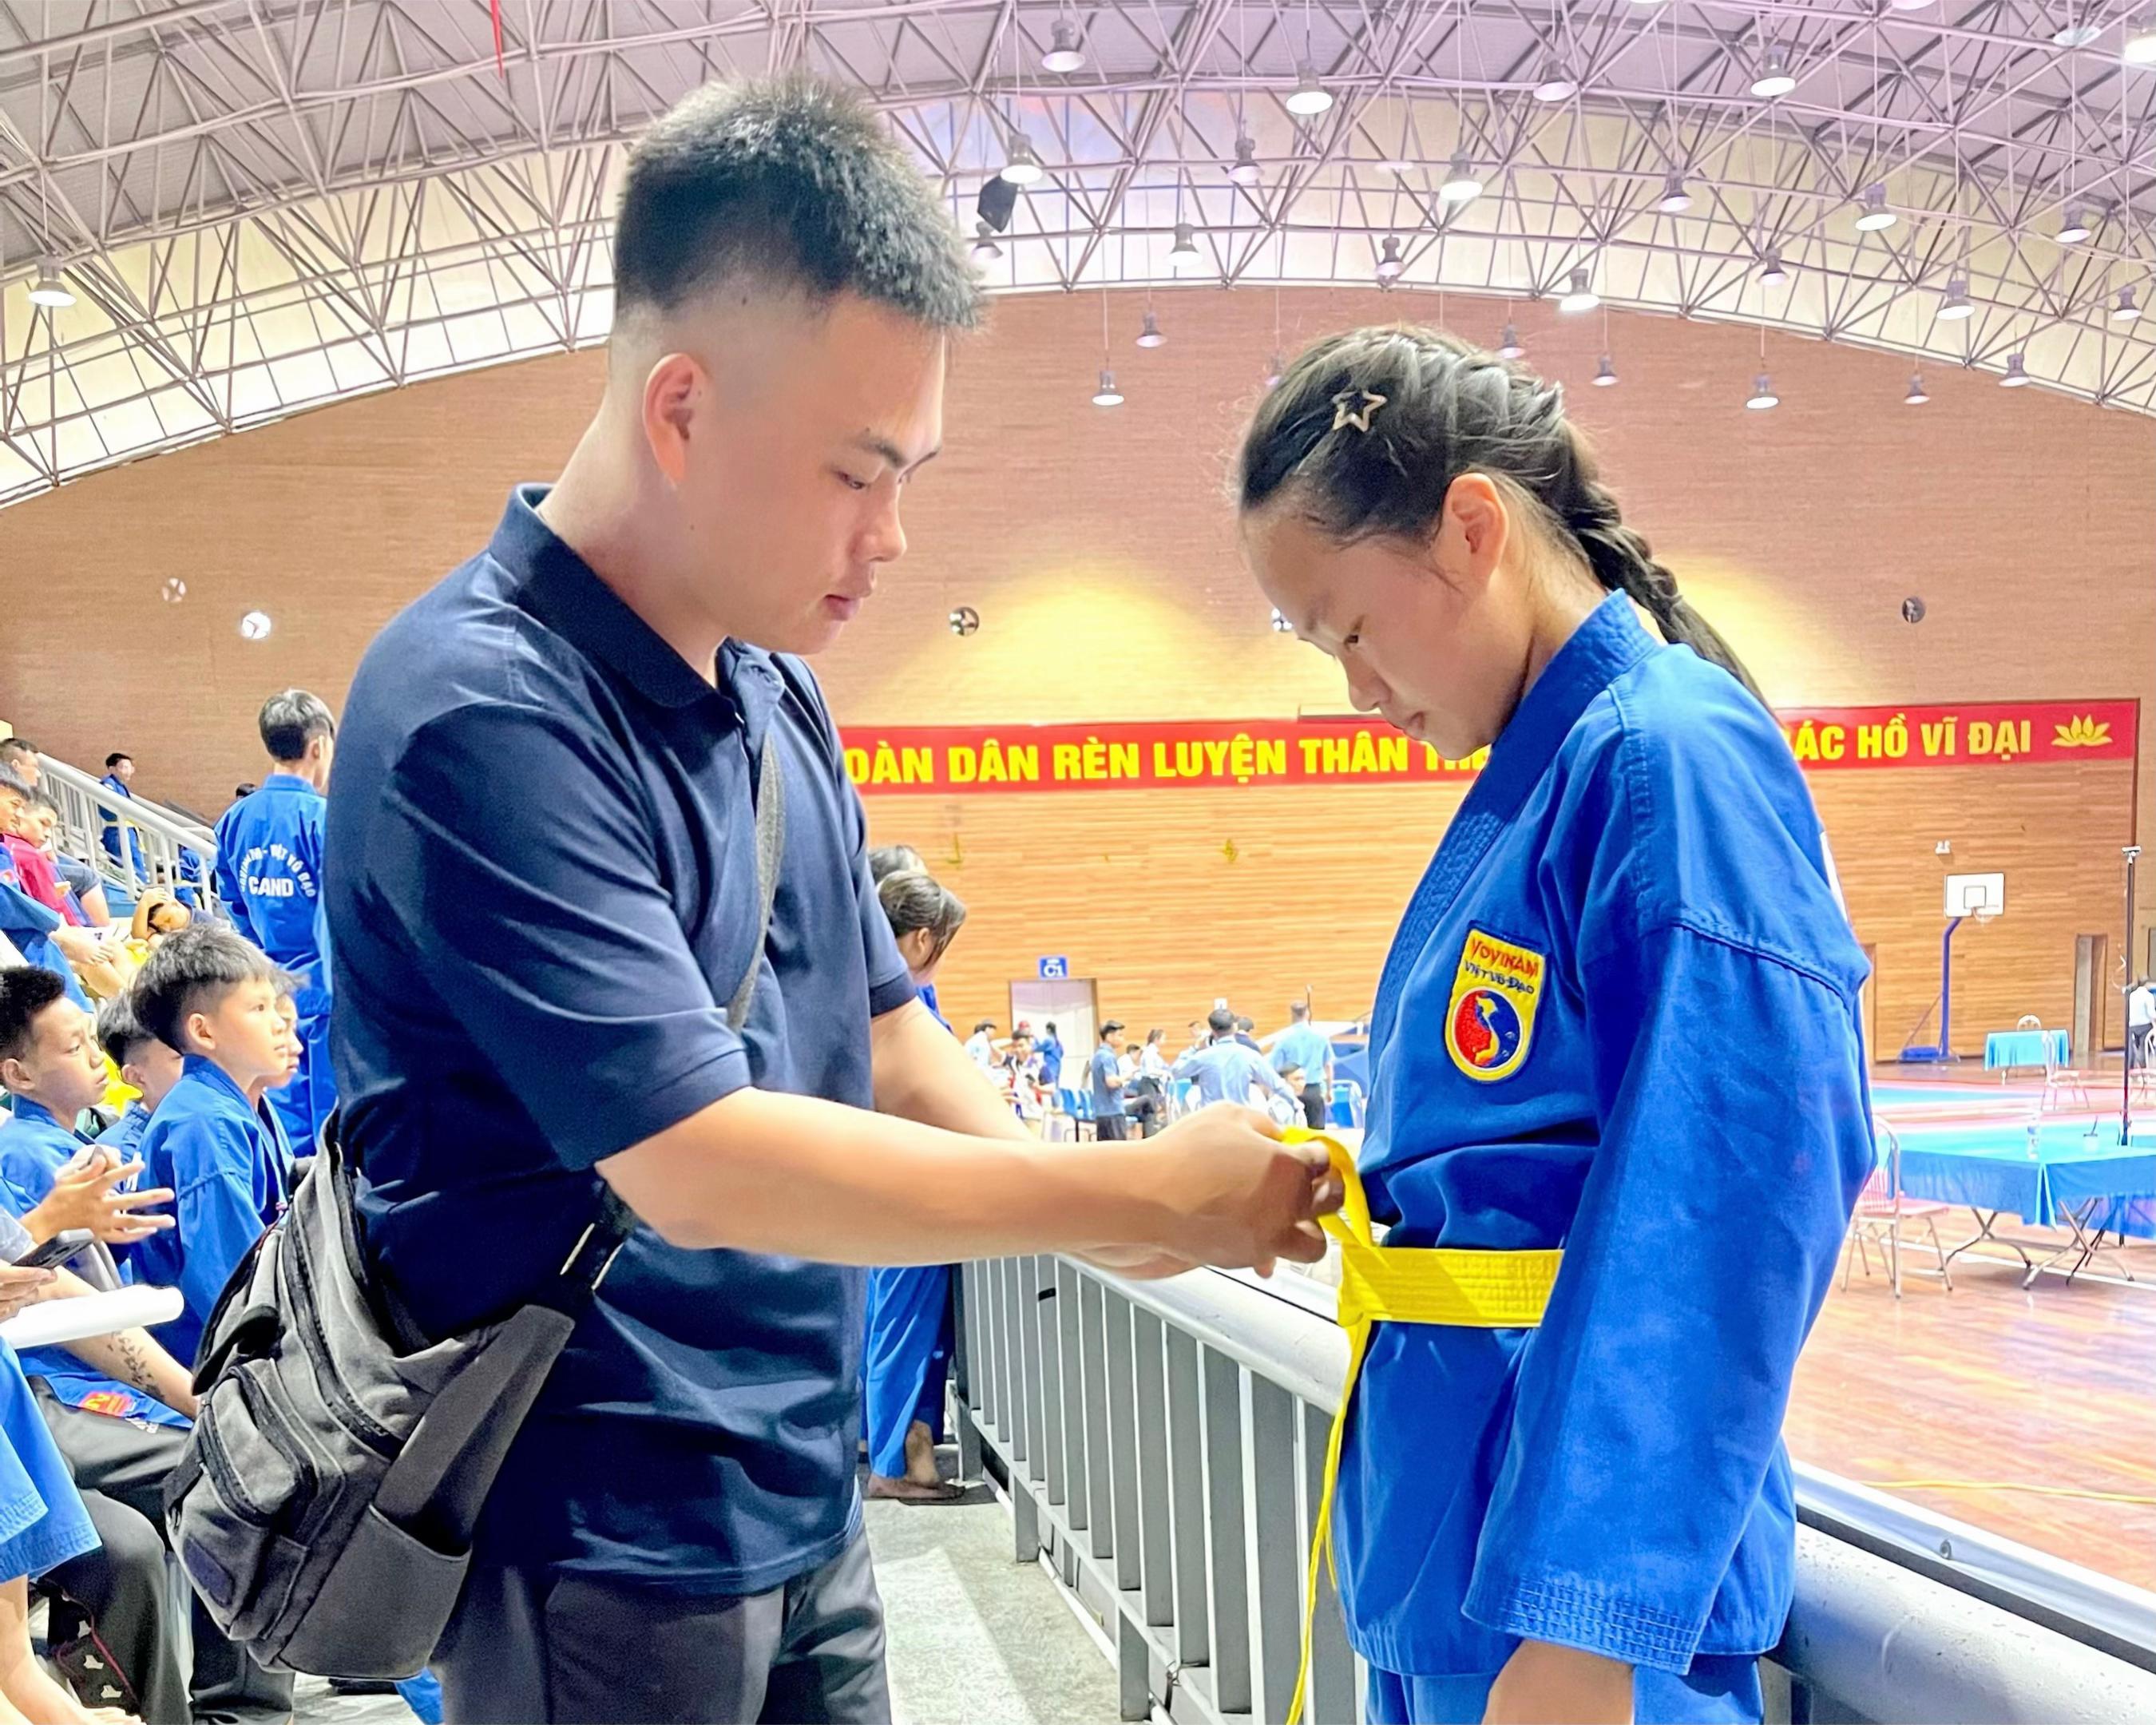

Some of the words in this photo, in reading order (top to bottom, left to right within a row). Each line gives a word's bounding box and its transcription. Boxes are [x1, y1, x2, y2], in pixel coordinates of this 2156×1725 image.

[842, 740, 934, 786] OÀN
[947, 739, 1039, 783] DÂN
[1052, 736, 1140, 780] RÈN
[1153, 732, 1286, 783] LUYỆN
[1298, 730, 1409, 774] THÂN
[1857, 712, 1908, 759] HỒ
[1920, 716, 1958, 756] VĨ
[1968, 720, 2031, 760] ĐẠI
[248, 876, 294, 897] CAND
